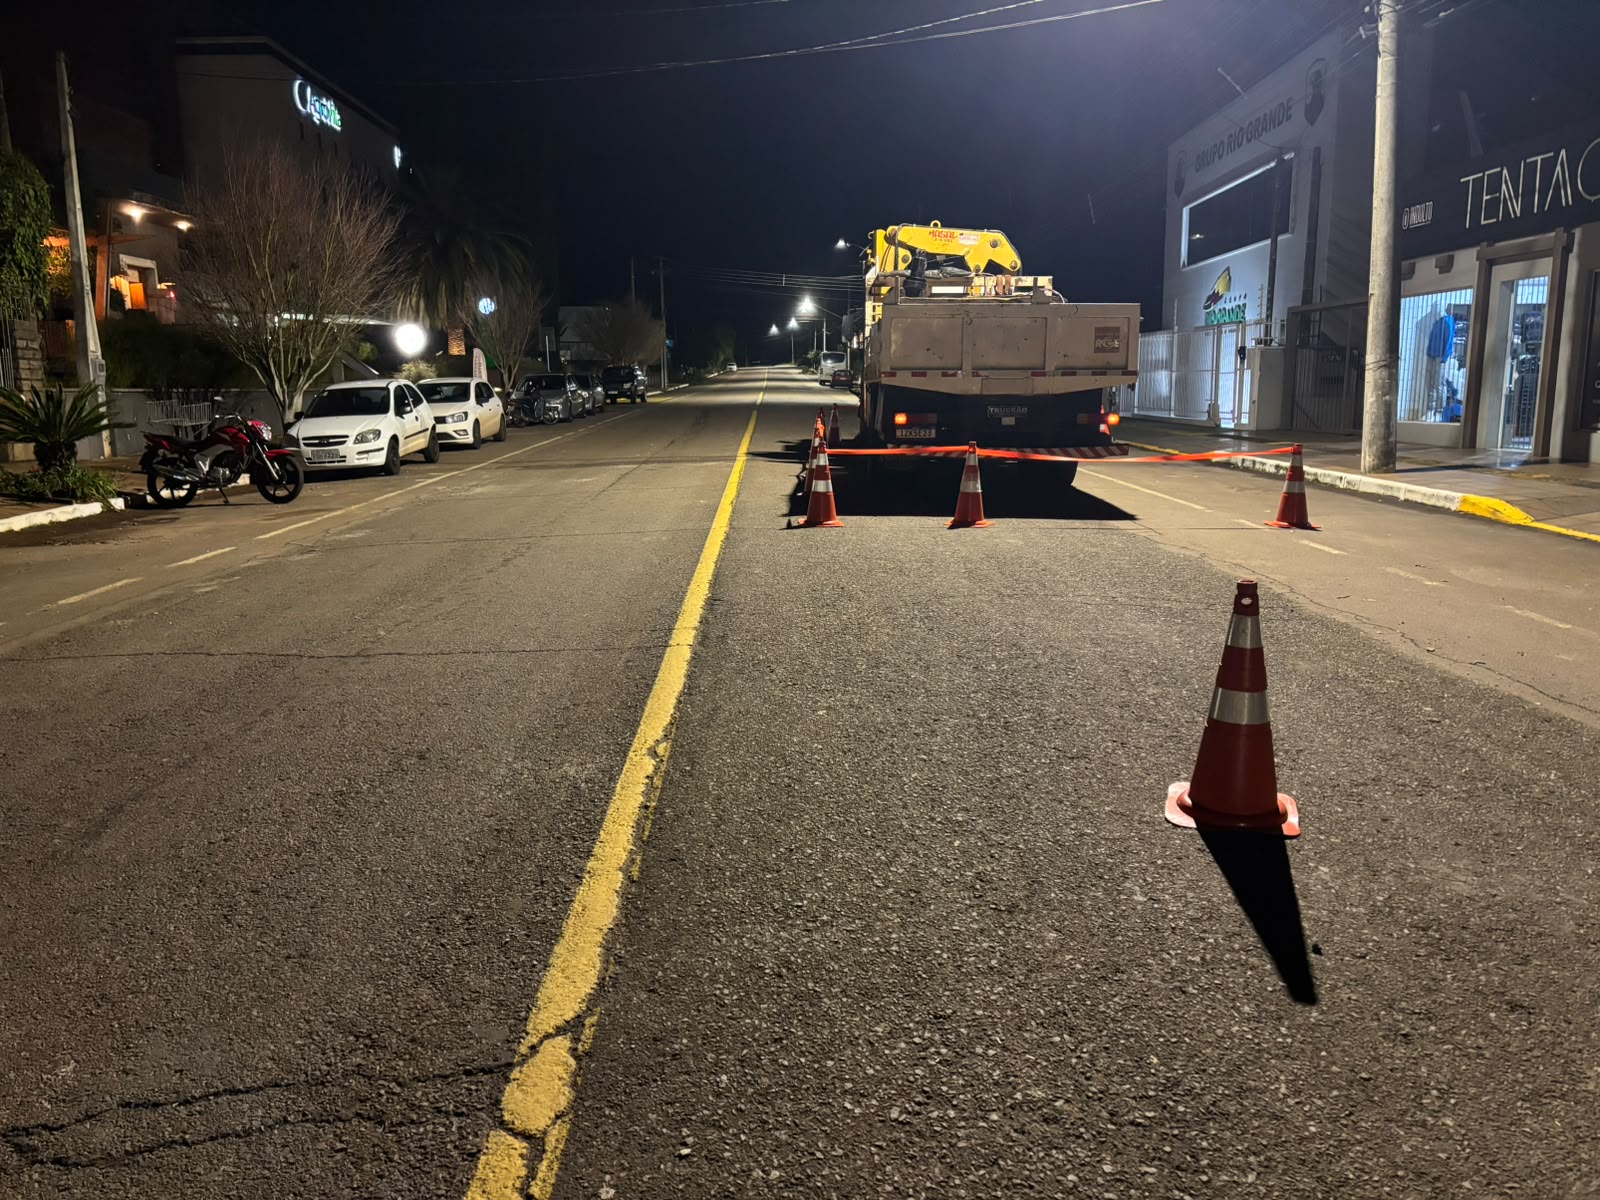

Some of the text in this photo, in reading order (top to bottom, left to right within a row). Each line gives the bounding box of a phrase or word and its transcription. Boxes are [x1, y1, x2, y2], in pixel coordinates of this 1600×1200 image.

[1195, 97, 1293, 173] GRUPO RIO GRANDE
[1409, 201, 1433, 225] INDULTO
